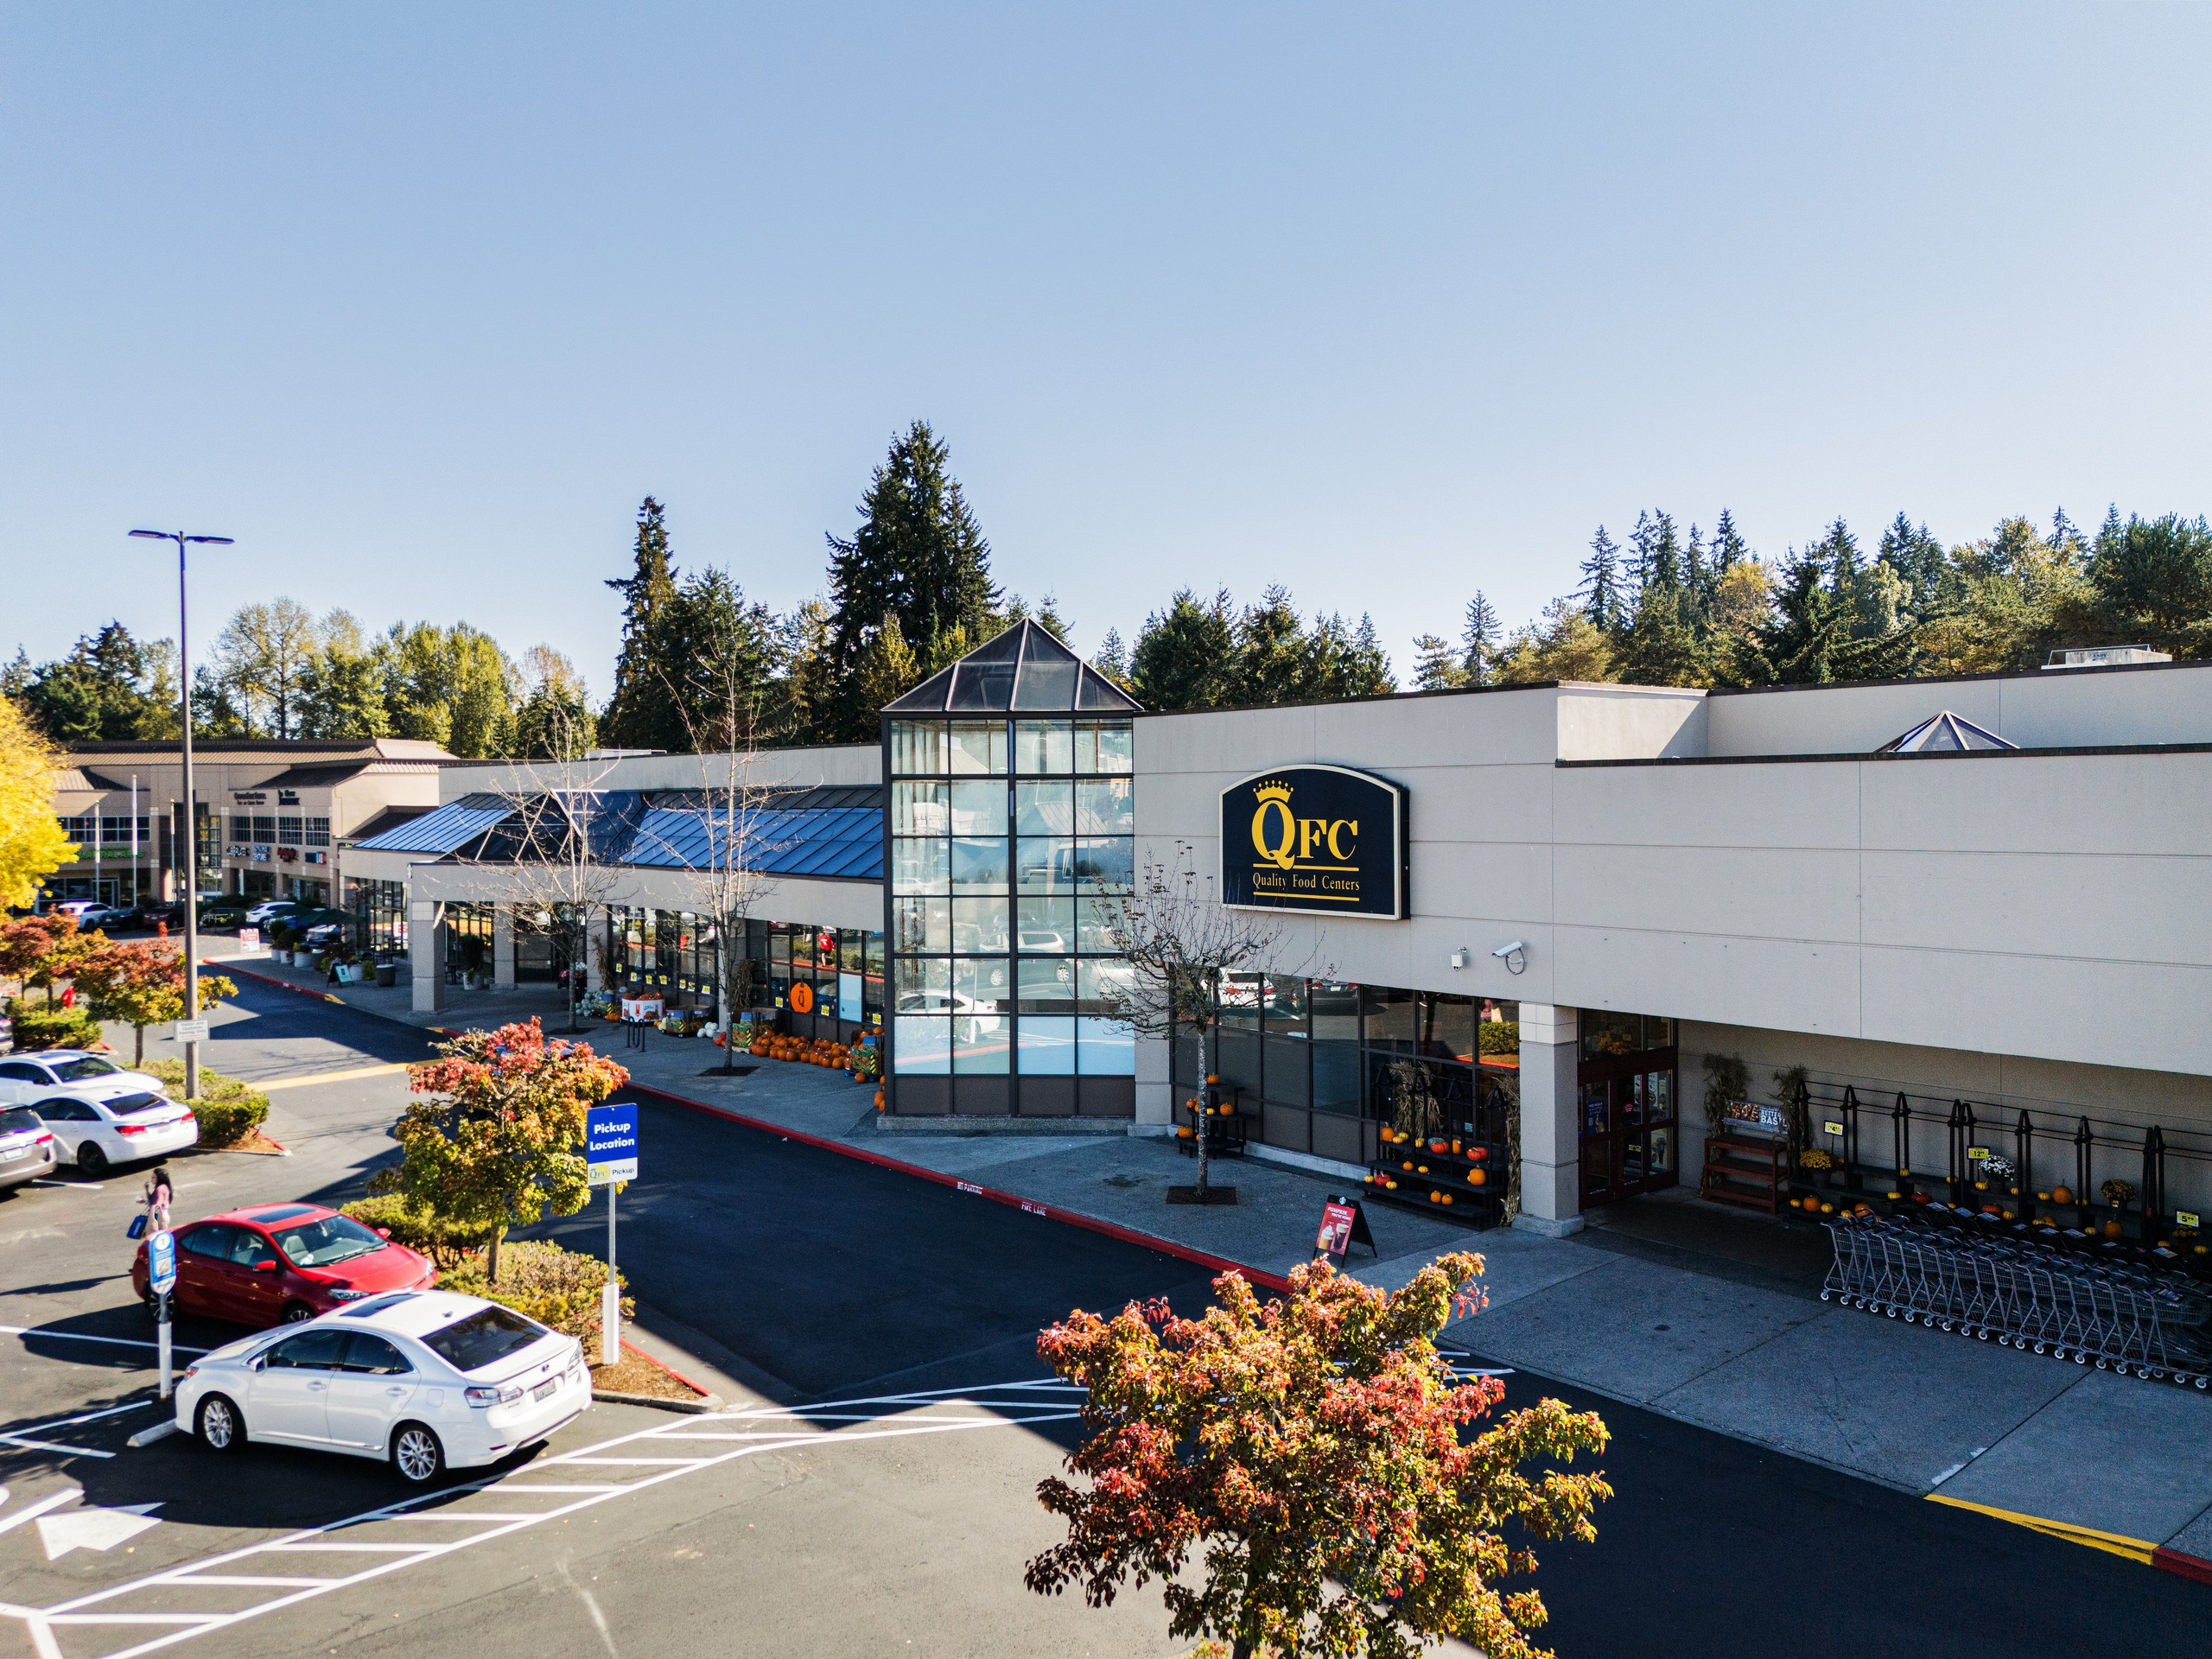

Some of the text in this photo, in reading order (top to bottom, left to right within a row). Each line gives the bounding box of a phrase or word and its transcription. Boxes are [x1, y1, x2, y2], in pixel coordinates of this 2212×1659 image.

[1251, 799, 1358, 871] QFC
[1253, 872, 1360, 891] Quality Food Centers
[594, 1122, 631, 1135] Pickup
[589, 1137, 635, 1152] Location
[612, 1167, 634, 1176] Pickup
[1021, 1201, 1046, 1217] FIRE LANE
